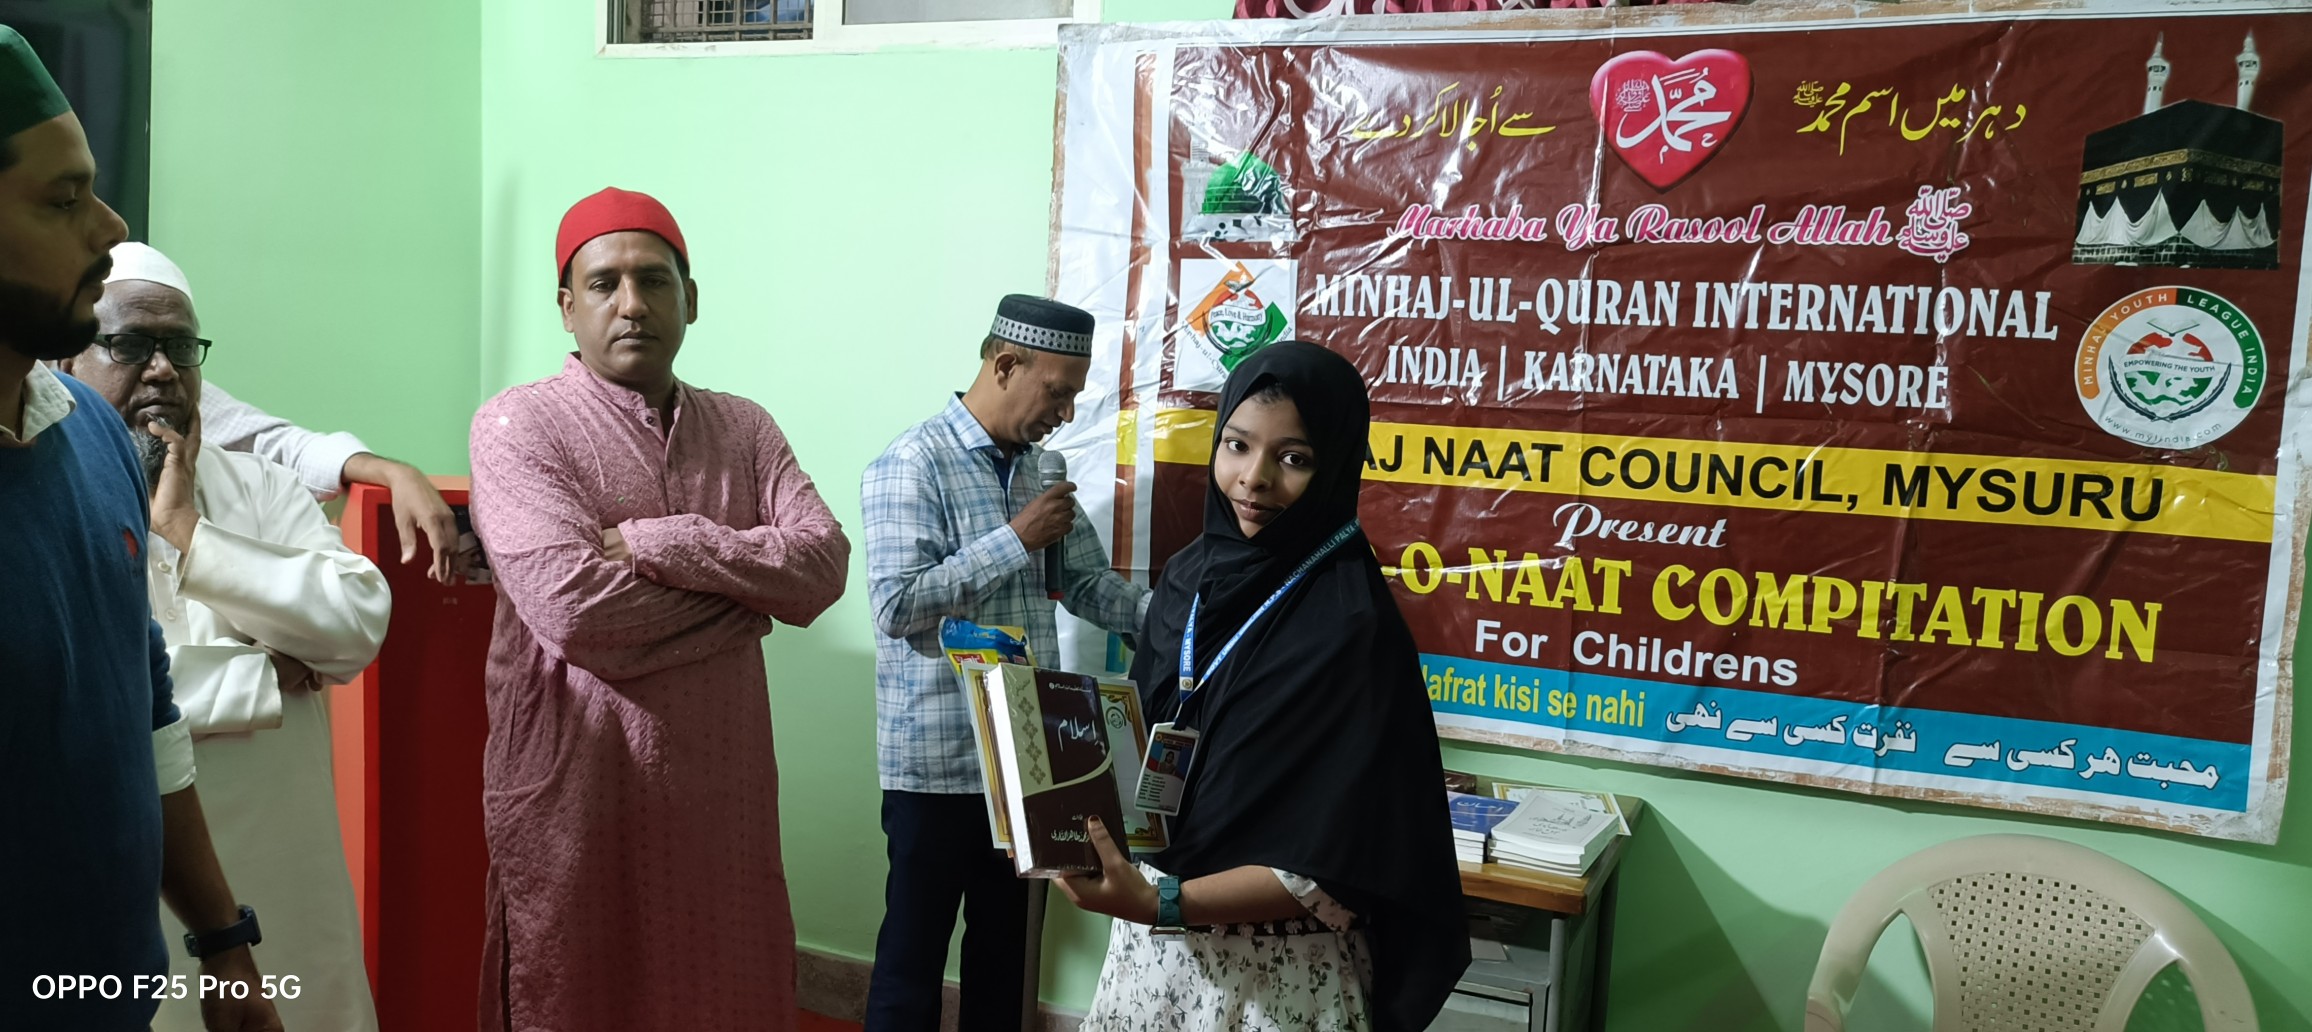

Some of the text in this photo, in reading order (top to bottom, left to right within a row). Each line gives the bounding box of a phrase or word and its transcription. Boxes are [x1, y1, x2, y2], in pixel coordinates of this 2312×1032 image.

[1386, 203, 1549, 243] Marhaba
[1556, 203, 1617, 252] Ya
[1625, 203, 1767, 245] Rasool
[1767, 204, 1894, 246] Allah
[1311, 274, 2058, 341] MINHAJ-UL-QURAN INTERNATIONAL
[2109, 292, 2168, 322] YOUTH
[2187, 294, 2249, 340] LEAGUE
[2241, 347, 2258, 394] INDIA
[2123, 360, 2216, 373] EMPOWERING THE YOUTH
[1385, 345, 1483, 388] INDIA
[1522, 350, 1740, 400] KARNATAKA
[1783, 360, 1949, 409] MYSORE
[1423, 437, 1564, 483] NAAT
[1579, 446, 1859, 511] COUNCIL,
[1882, 463, 2164, 521] MYSURU
[1552, 502, 1728, 551] Present
[1652, 564, 2162, 664] COMPITATION
[1474, 619, 1798, 687] For Childrens
[1493, 674, 1540, 713] kisi
[1547, 689, 1577, 719] se
[1586, 689, 1646, 728] nahi
